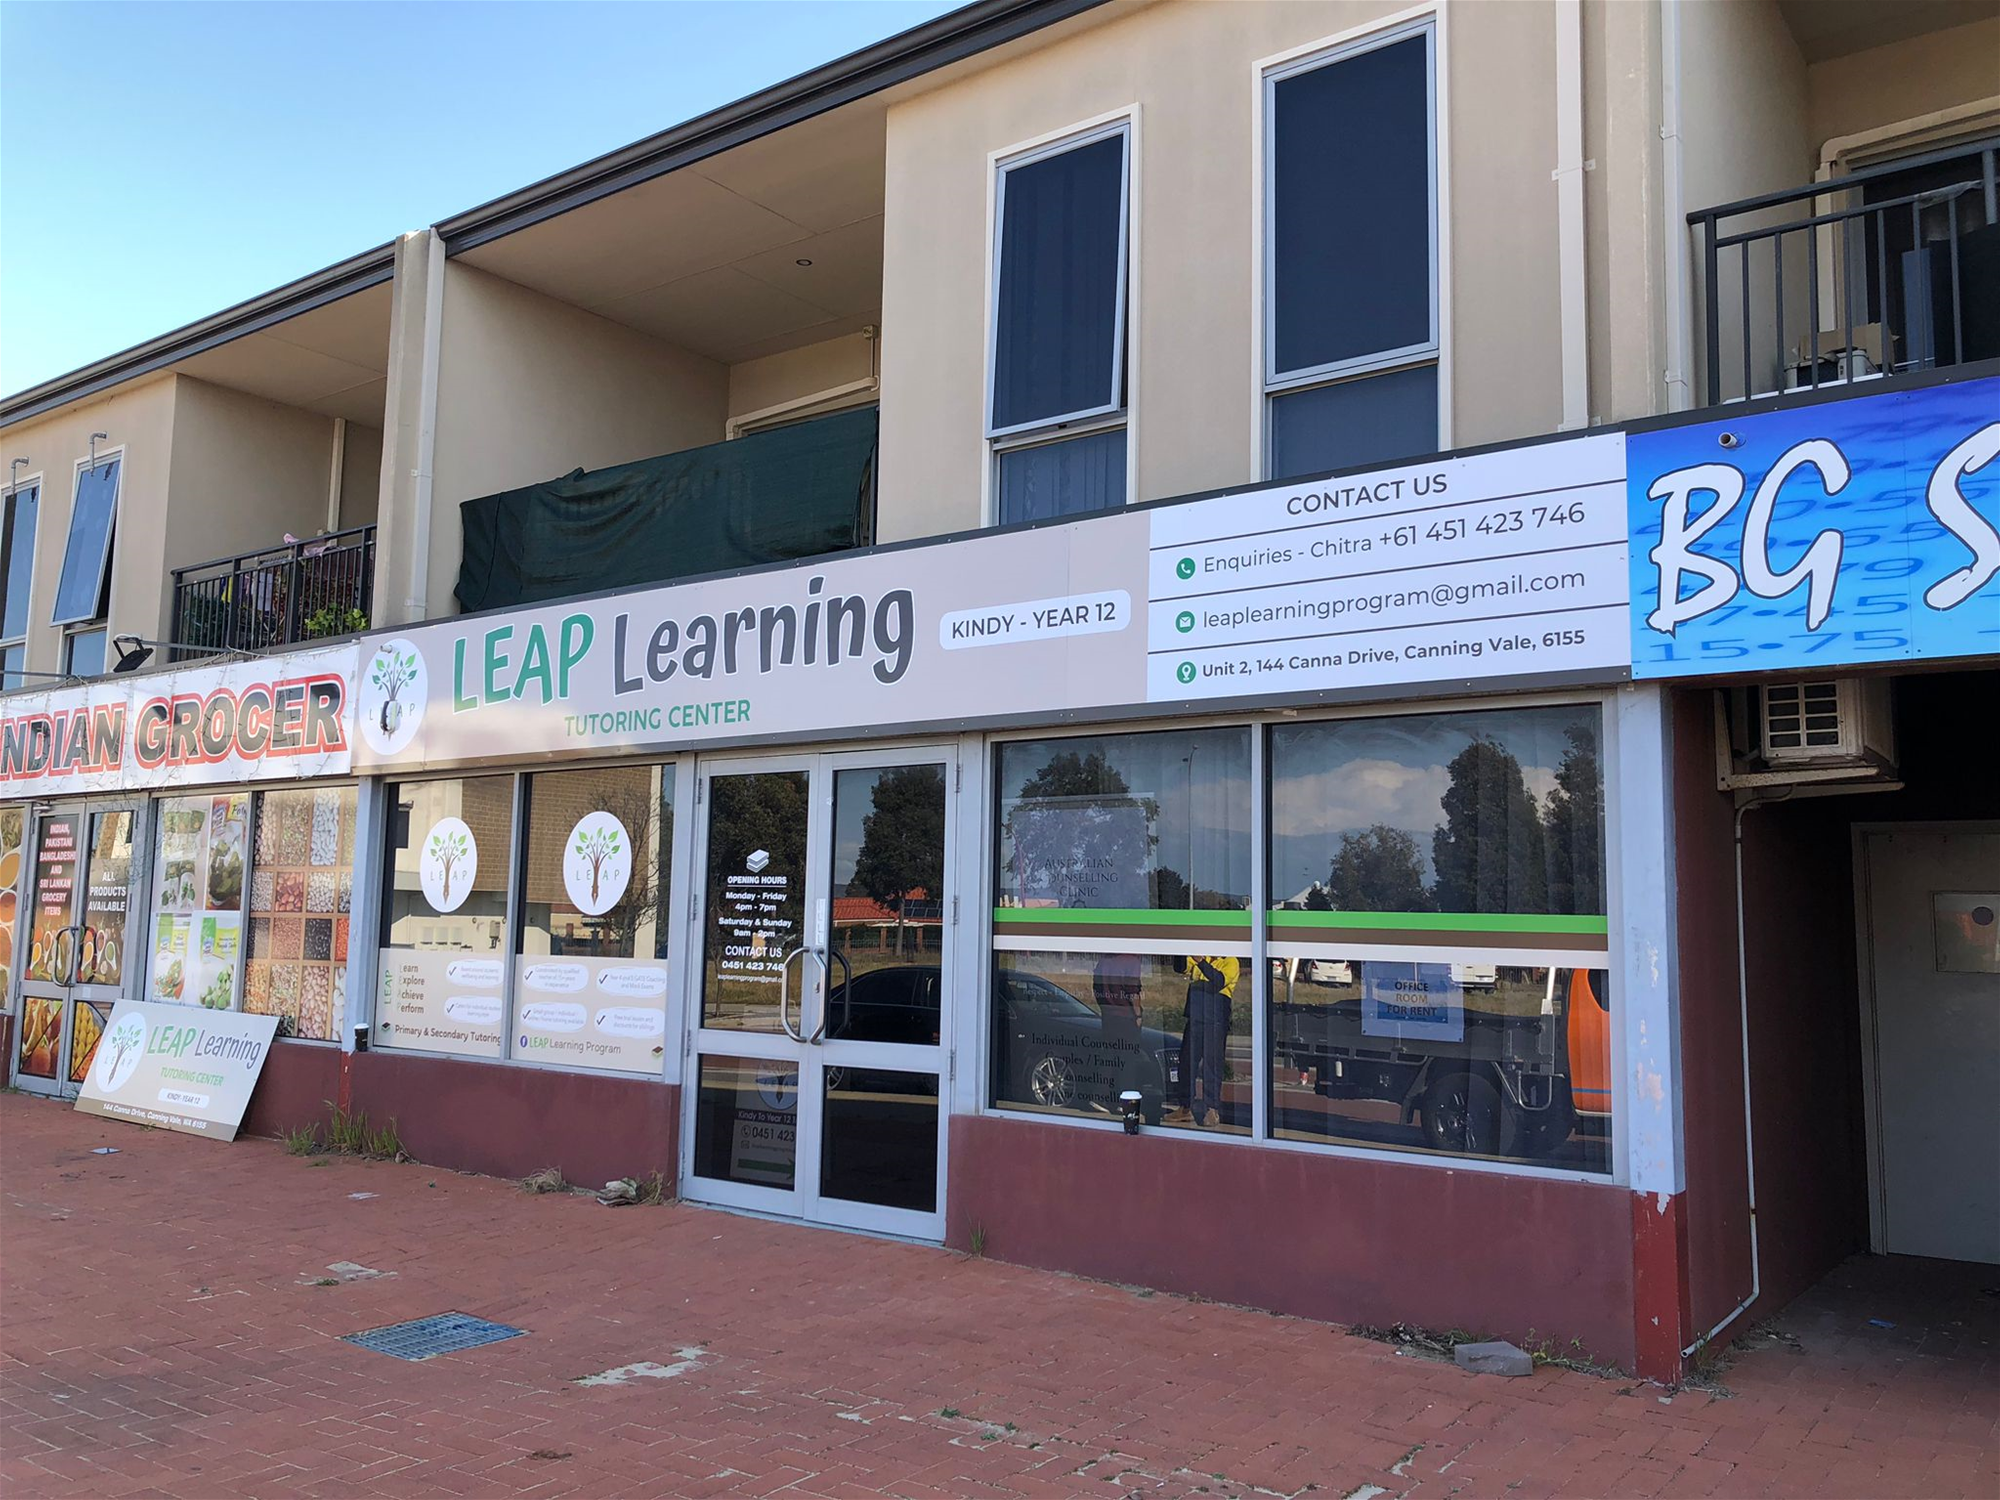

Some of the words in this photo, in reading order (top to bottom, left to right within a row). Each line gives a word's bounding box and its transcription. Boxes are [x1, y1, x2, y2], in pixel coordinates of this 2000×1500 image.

[1287, 480, 1406, 515] CONTACT
[1413, 473, 1448, 496] US
[1204, 548, 1292, 573] Enquiries
[1310, 537, 1372, 558] Chitra
[1379, 525, 1417, 547] +61
[1426, 518, 1466, 542] 451
[1475, 510, 1523, 535] 423
[1532, 502, 1585, 528] 746
[1647, 437, 1852, 638] BG
[1203, 572, 1585, 629] leaplearningprogram@gmail.com
[952, 614, 1015, 639] KINDY
[1032, 605, 1089, 629] YEAR
[1095, 602, 1116, 622] 12
[452, 611, 596, 715] LEAP
[612, 574, 916, 697] Learning
[1202, 662, 1235, 677] Unit
[1239, 661, 1252, 675] 2,
[1256, 658, 1284, 672] 144
[1288, 654, 1342, 669] Canna
[1348, 648, 1399, 664] Drive,
[1404, 640, 1483, 660] Canning
[1488, 634, 1537, 652] Vale,
[1542, 629, 1585, 647] 6155
[564, 706, 662, 737] TUTORING
[669, 699, 751, 728] CENTER
[0, 702, 127, 781] NDIAN
[134, 673, 348, 770] GROCER
[50, 865, 63, 875] AND
[102, 871, 116, 882] ALL
[727, 875, 760, 885] OPENING
[761, 875, 787, 885] HOURS
[41, 892, 68, 903] GROCERY
[89, 886, 127, 897] PRODUCTS
[726, 892, 755, 901] Monday
[762, 892, 787, 901] Friday
[1059, 886, 1100, 898] CLINIC
[88, 901, 126, 912] AVAILABLE
[735, 903, 753, 911] 4pm
[759, 903, 777, 912] 7pm
[718, 917, 753, 927] Saturday
[754, 918, 761, 926] &
[762, 918, 792, 928] Sunday
[733, 930, 751, 938] 9am
[758, 930, 776, 939] 2pm
[725, 945, 767, 958] CONTACT
[769, 947, 783, 958] US
[722, 961, 744, 970] 0451
[746, 962, 764, 970] 423
[1394, 981, 1429, 992] OFFICE
[1395, 993, 1428, 1004] ROOM
[1386, 1004, 1407, 1015] FOR
[1409, 1006, 1438, 1017] RENT
[395, 1025, 422, 1038] Primary
[423, 1027, 429, 1036] &
[430, 1027, 469, 1042] Secondary
[146, 1025, 197, 1058] LEAP
[195, 1029, 262, 1070] Learning
[529, 1036, 549, 1048] LEAP
[549, 1038, 584, 1053] Learning
[585, 1041, 621, 1055] Program
[1032, 1033, 1079, 1047] Individual
[1081, 1035, 1140, 1053] Counselling
[1094, 1056, 1126, 1071] Family
[160, 1066, 195, 1084] TUTORING
[195, 1073, 225, 1087] CENTER
[738, 1110, 756, 1122] Kindy
[767, 1113, 783, 1123] Year
[752, 1126, 774, 1140] 0451
[777, 1130, 795, 1142] 423
